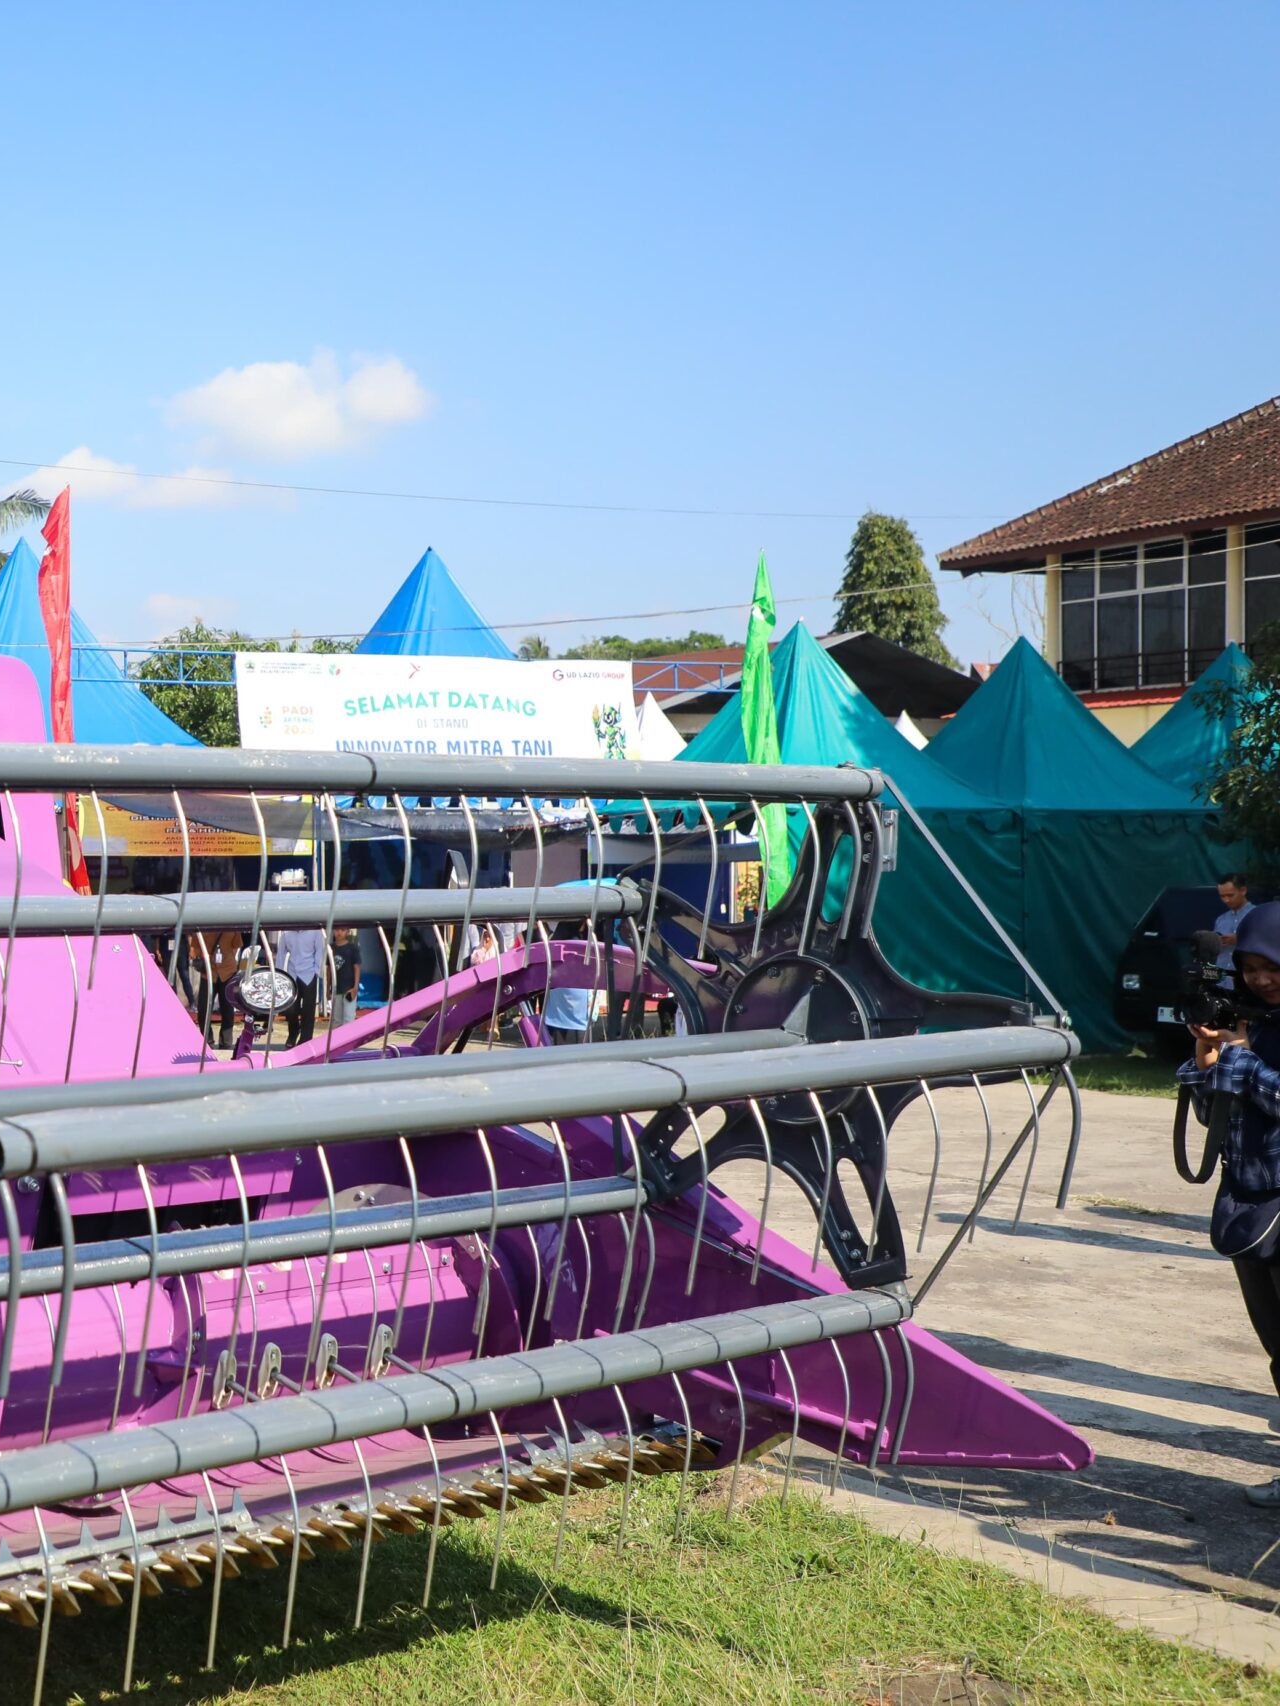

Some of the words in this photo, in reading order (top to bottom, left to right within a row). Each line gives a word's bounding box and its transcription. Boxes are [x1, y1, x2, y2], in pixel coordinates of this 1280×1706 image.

[566, 671, 577, 679] UD
[578, 671, 600, 679] LAZIO
[601, 672, 626, 680] GROUP
[343, 691, 441, 717] SELAMAT
[447, 691, 538, 717] DATANG
[281, 705, 314, 716] PADI
[416, 717, 428, 729] DI
[432, 717, 469, 729] STAND
[335, 739, 437, 755] INNOVATOR
[446, 739, 503, 757] MITRA
[511, 739, 553, 757] TANI
